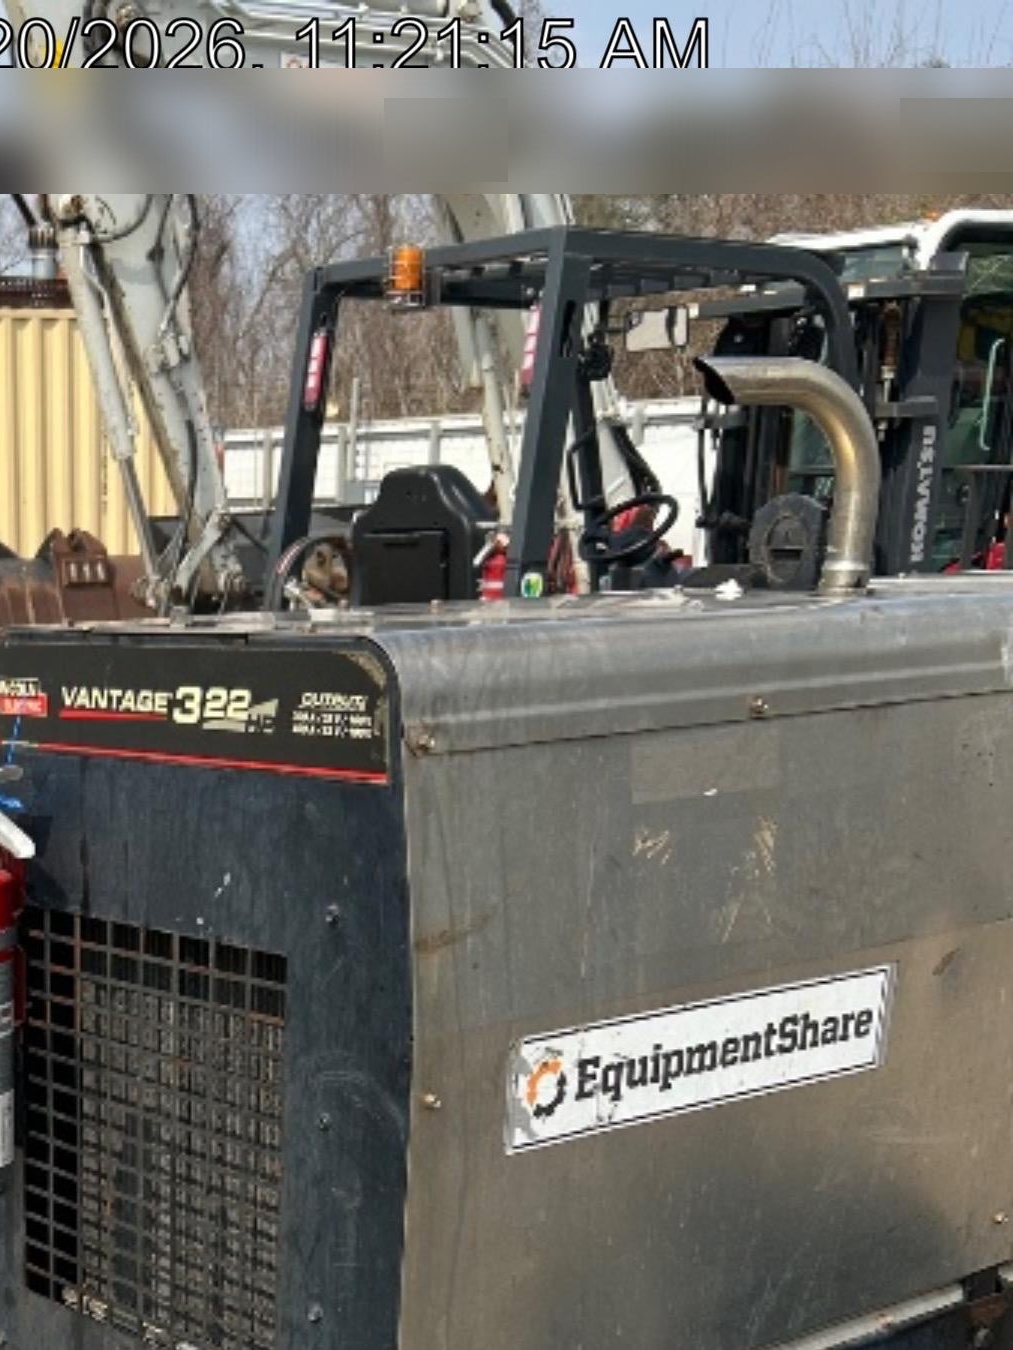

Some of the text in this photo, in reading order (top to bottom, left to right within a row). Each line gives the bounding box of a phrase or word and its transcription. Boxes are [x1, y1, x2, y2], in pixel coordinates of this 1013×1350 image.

[910, 425, 936, 562] KOMATSU
[60, 685, 170, 714] VANTAGE
[171, 685, 252, 725] 322
[574, 1007, 874, 1102] EquipmentShare
